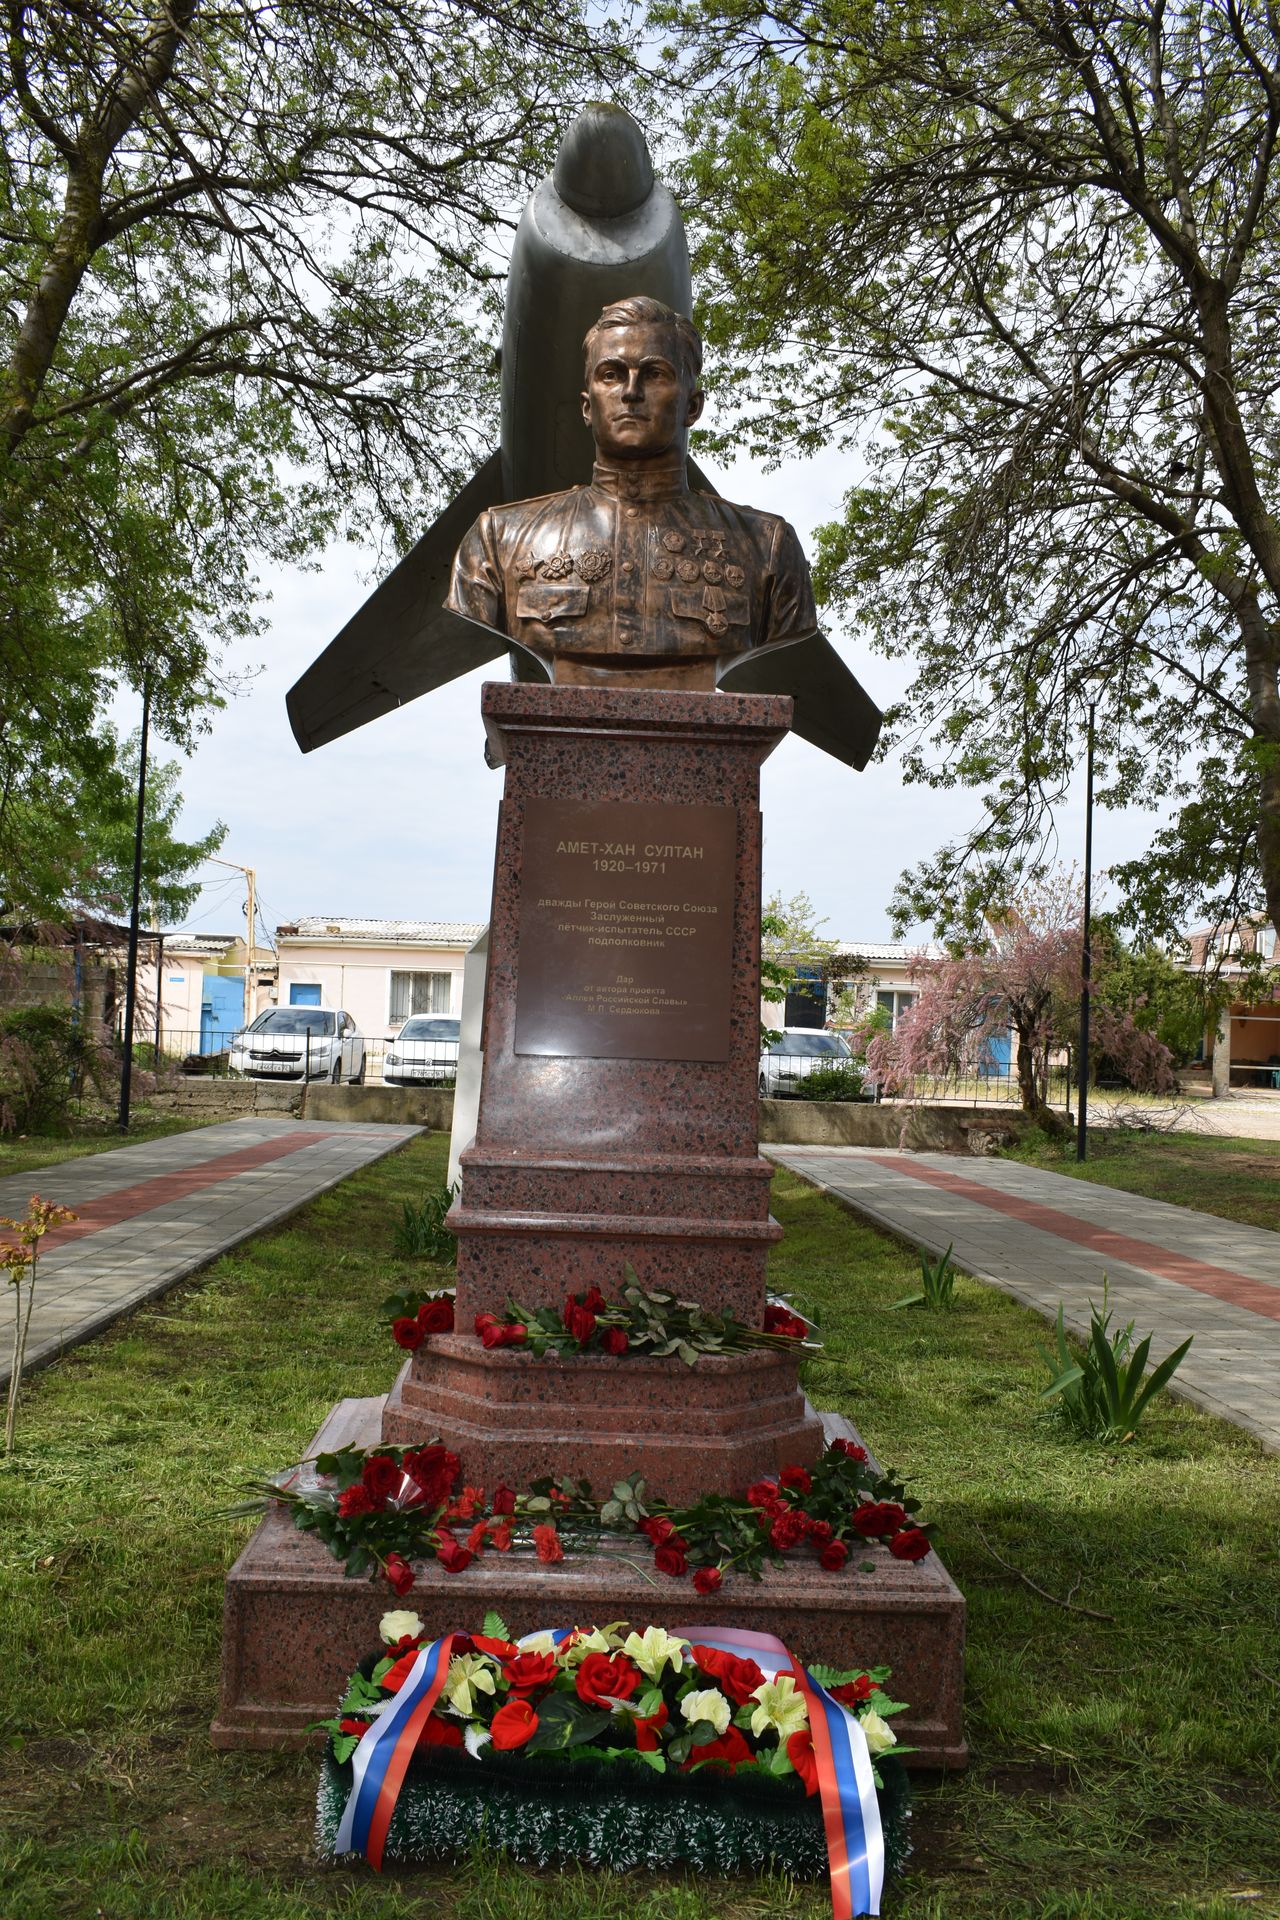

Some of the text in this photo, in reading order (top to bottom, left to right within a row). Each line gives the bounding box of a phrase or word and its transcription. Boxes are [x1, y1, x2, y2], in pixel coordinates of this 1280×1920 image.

[556, 841, 704, 859] АМЕТ-ХАН СУЛТАН
[537, 899, 718, 913] дважды Герой Советского Союза
[590, 911, 665, 924] Заслуженный
[665, 926, 697, 937] СССР
[588, 936, 665, 949] подполковник
[616, 975, 634, 984] Дар
[629, 987, 666, 995] проекта
